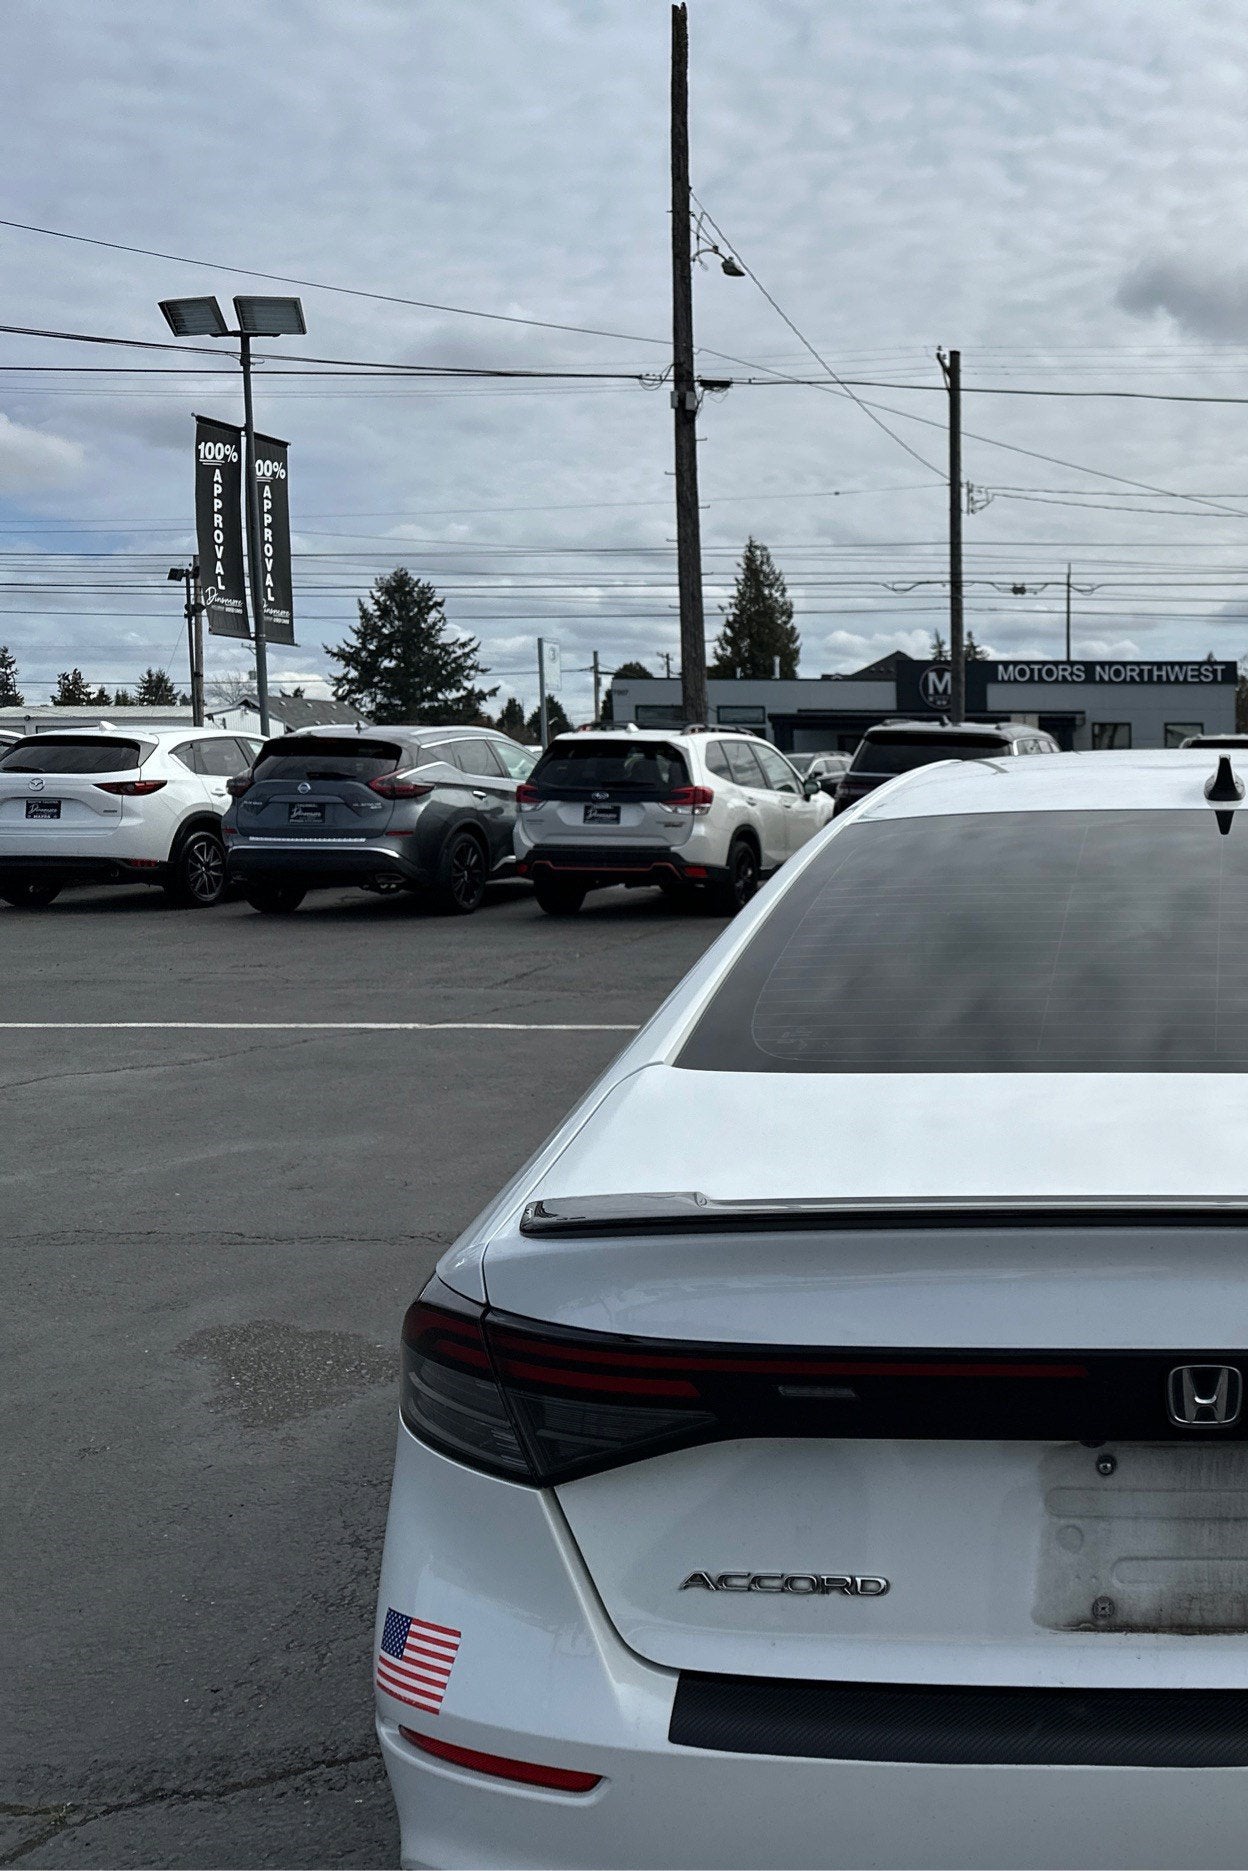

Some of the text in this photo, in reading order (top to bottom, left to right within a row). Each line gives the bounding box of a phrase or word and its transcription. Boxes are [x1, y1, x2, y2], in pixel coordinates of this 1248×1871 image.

[198, 440, 239, 464] 100%
[254, 458, 287, 481] 00%
[212, 468, 226, 591] APPROVAL
[262, 484, 275, 602] APPROVAL
[997, 664, 1226, 683] MOTORS NORTHWEST
[678, 1570, 891, 1597] ACCORD
